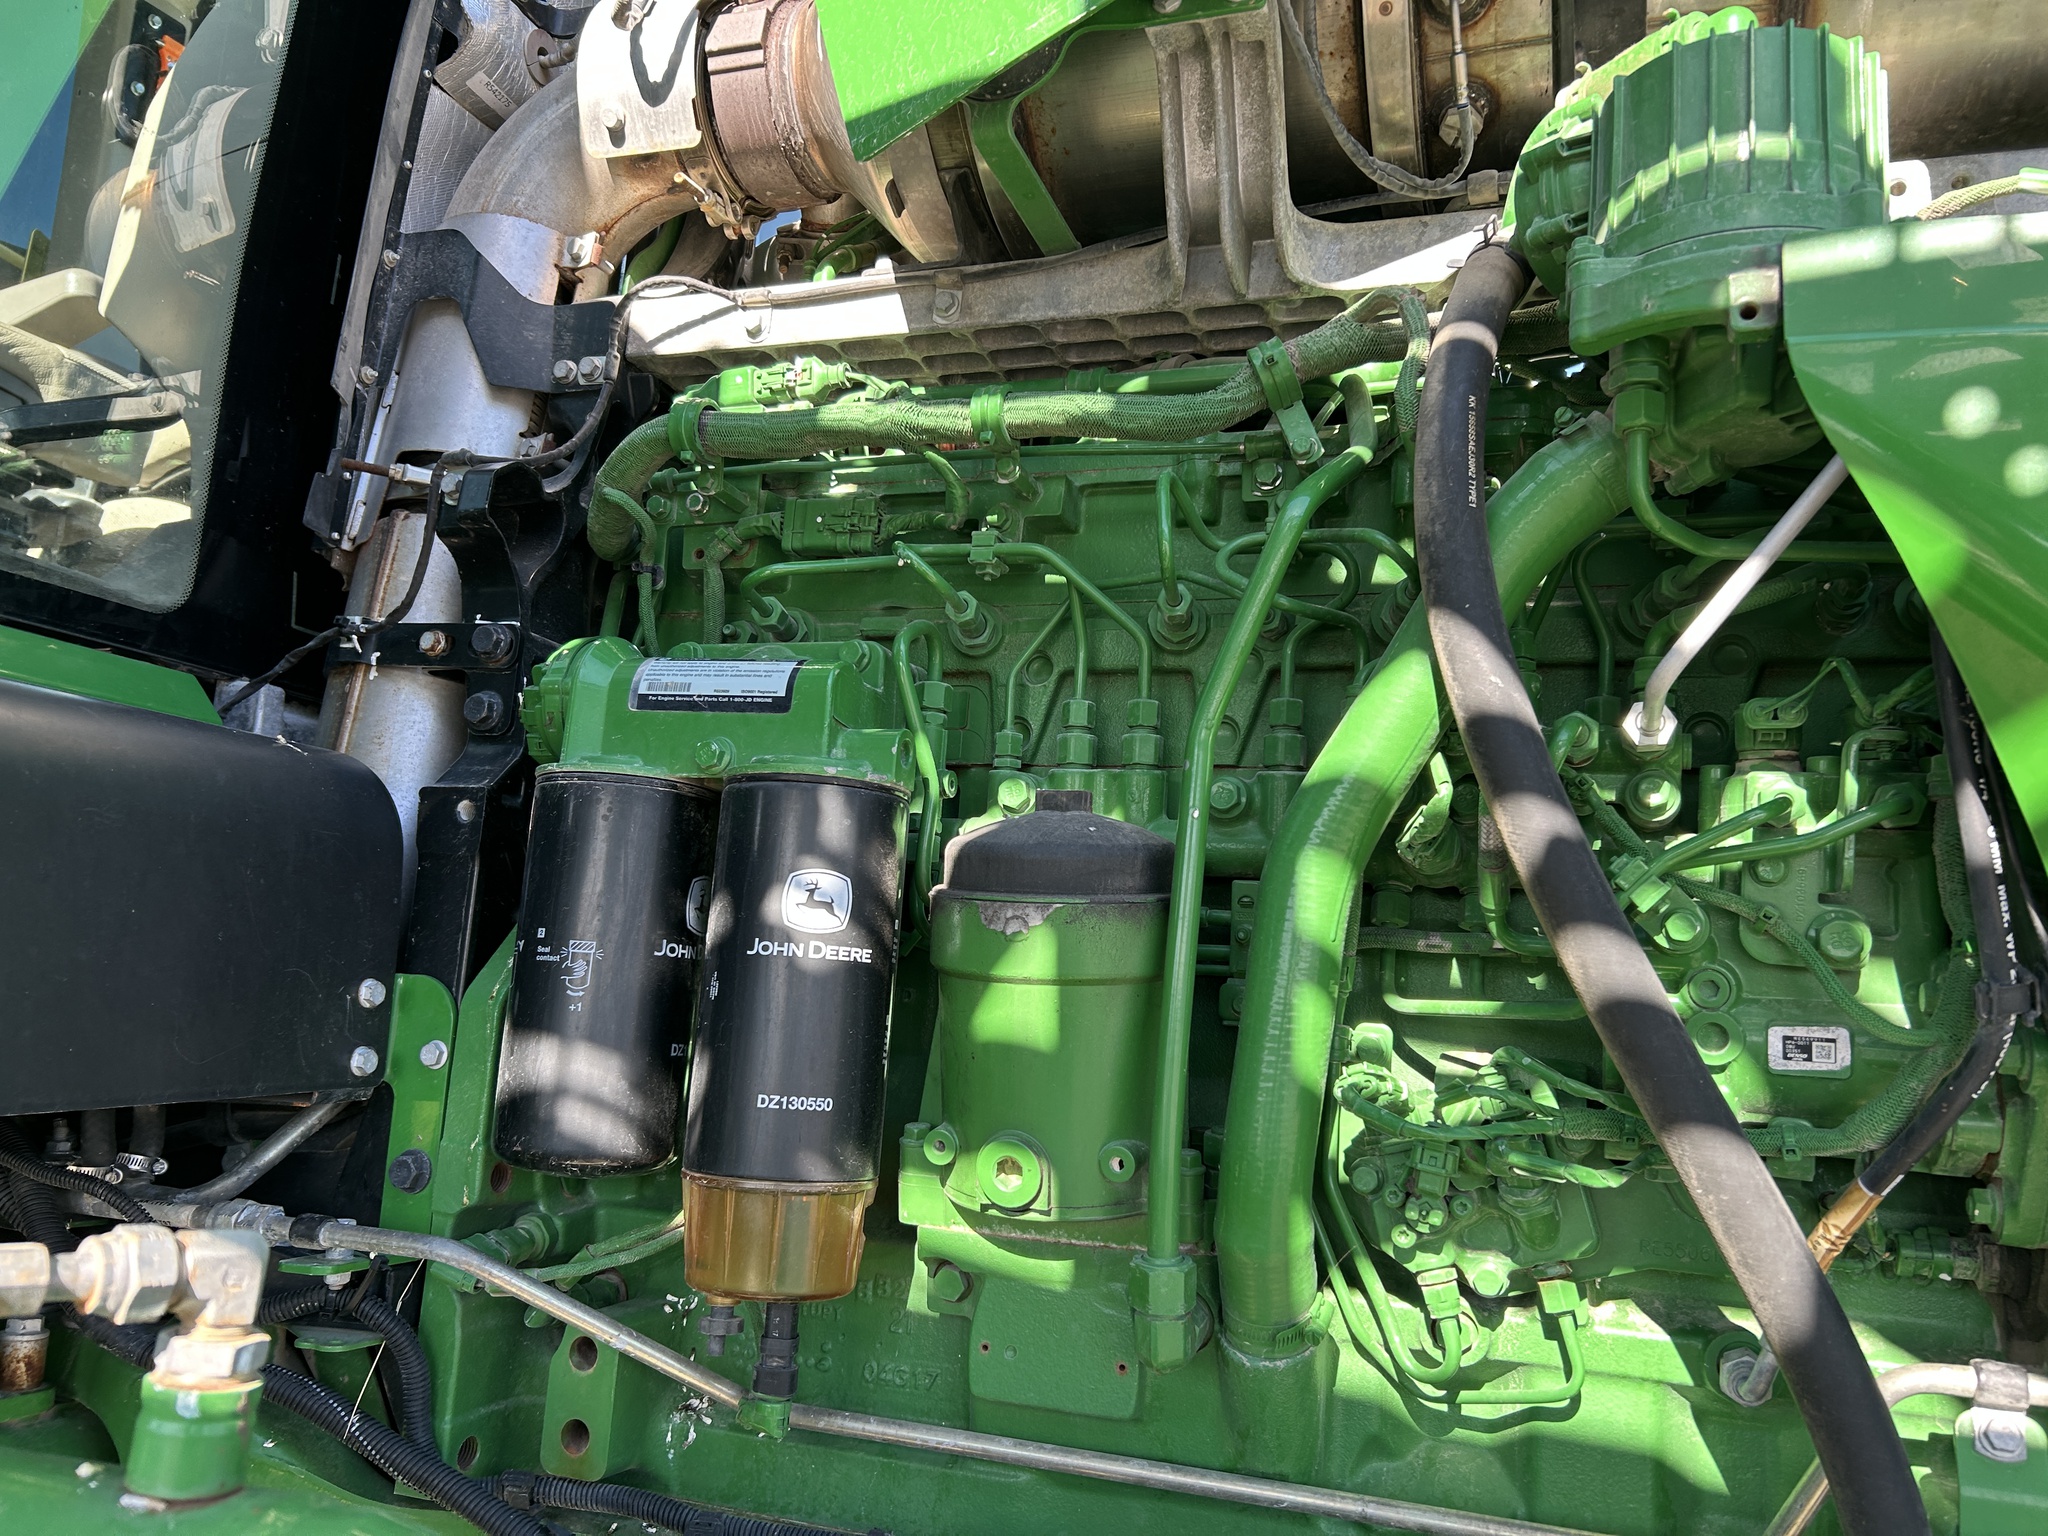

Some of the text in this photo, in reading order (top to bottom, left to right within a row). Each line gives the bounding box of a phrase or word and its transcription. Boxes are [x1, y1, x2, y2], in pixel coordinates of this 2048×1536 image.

[484, 81, 512, 107] R542175
[536, 954, 560, 962] contact
[537, 945, 551, 953] Seal
[654, 939, 696, 960] JOHN
[747, 937, 804, 958] JOHN
[808, 940, 872, 964] DEERE
[568, 1002, 582, 1012] +1
[756, 1093, 833, 1112] DZ130550
